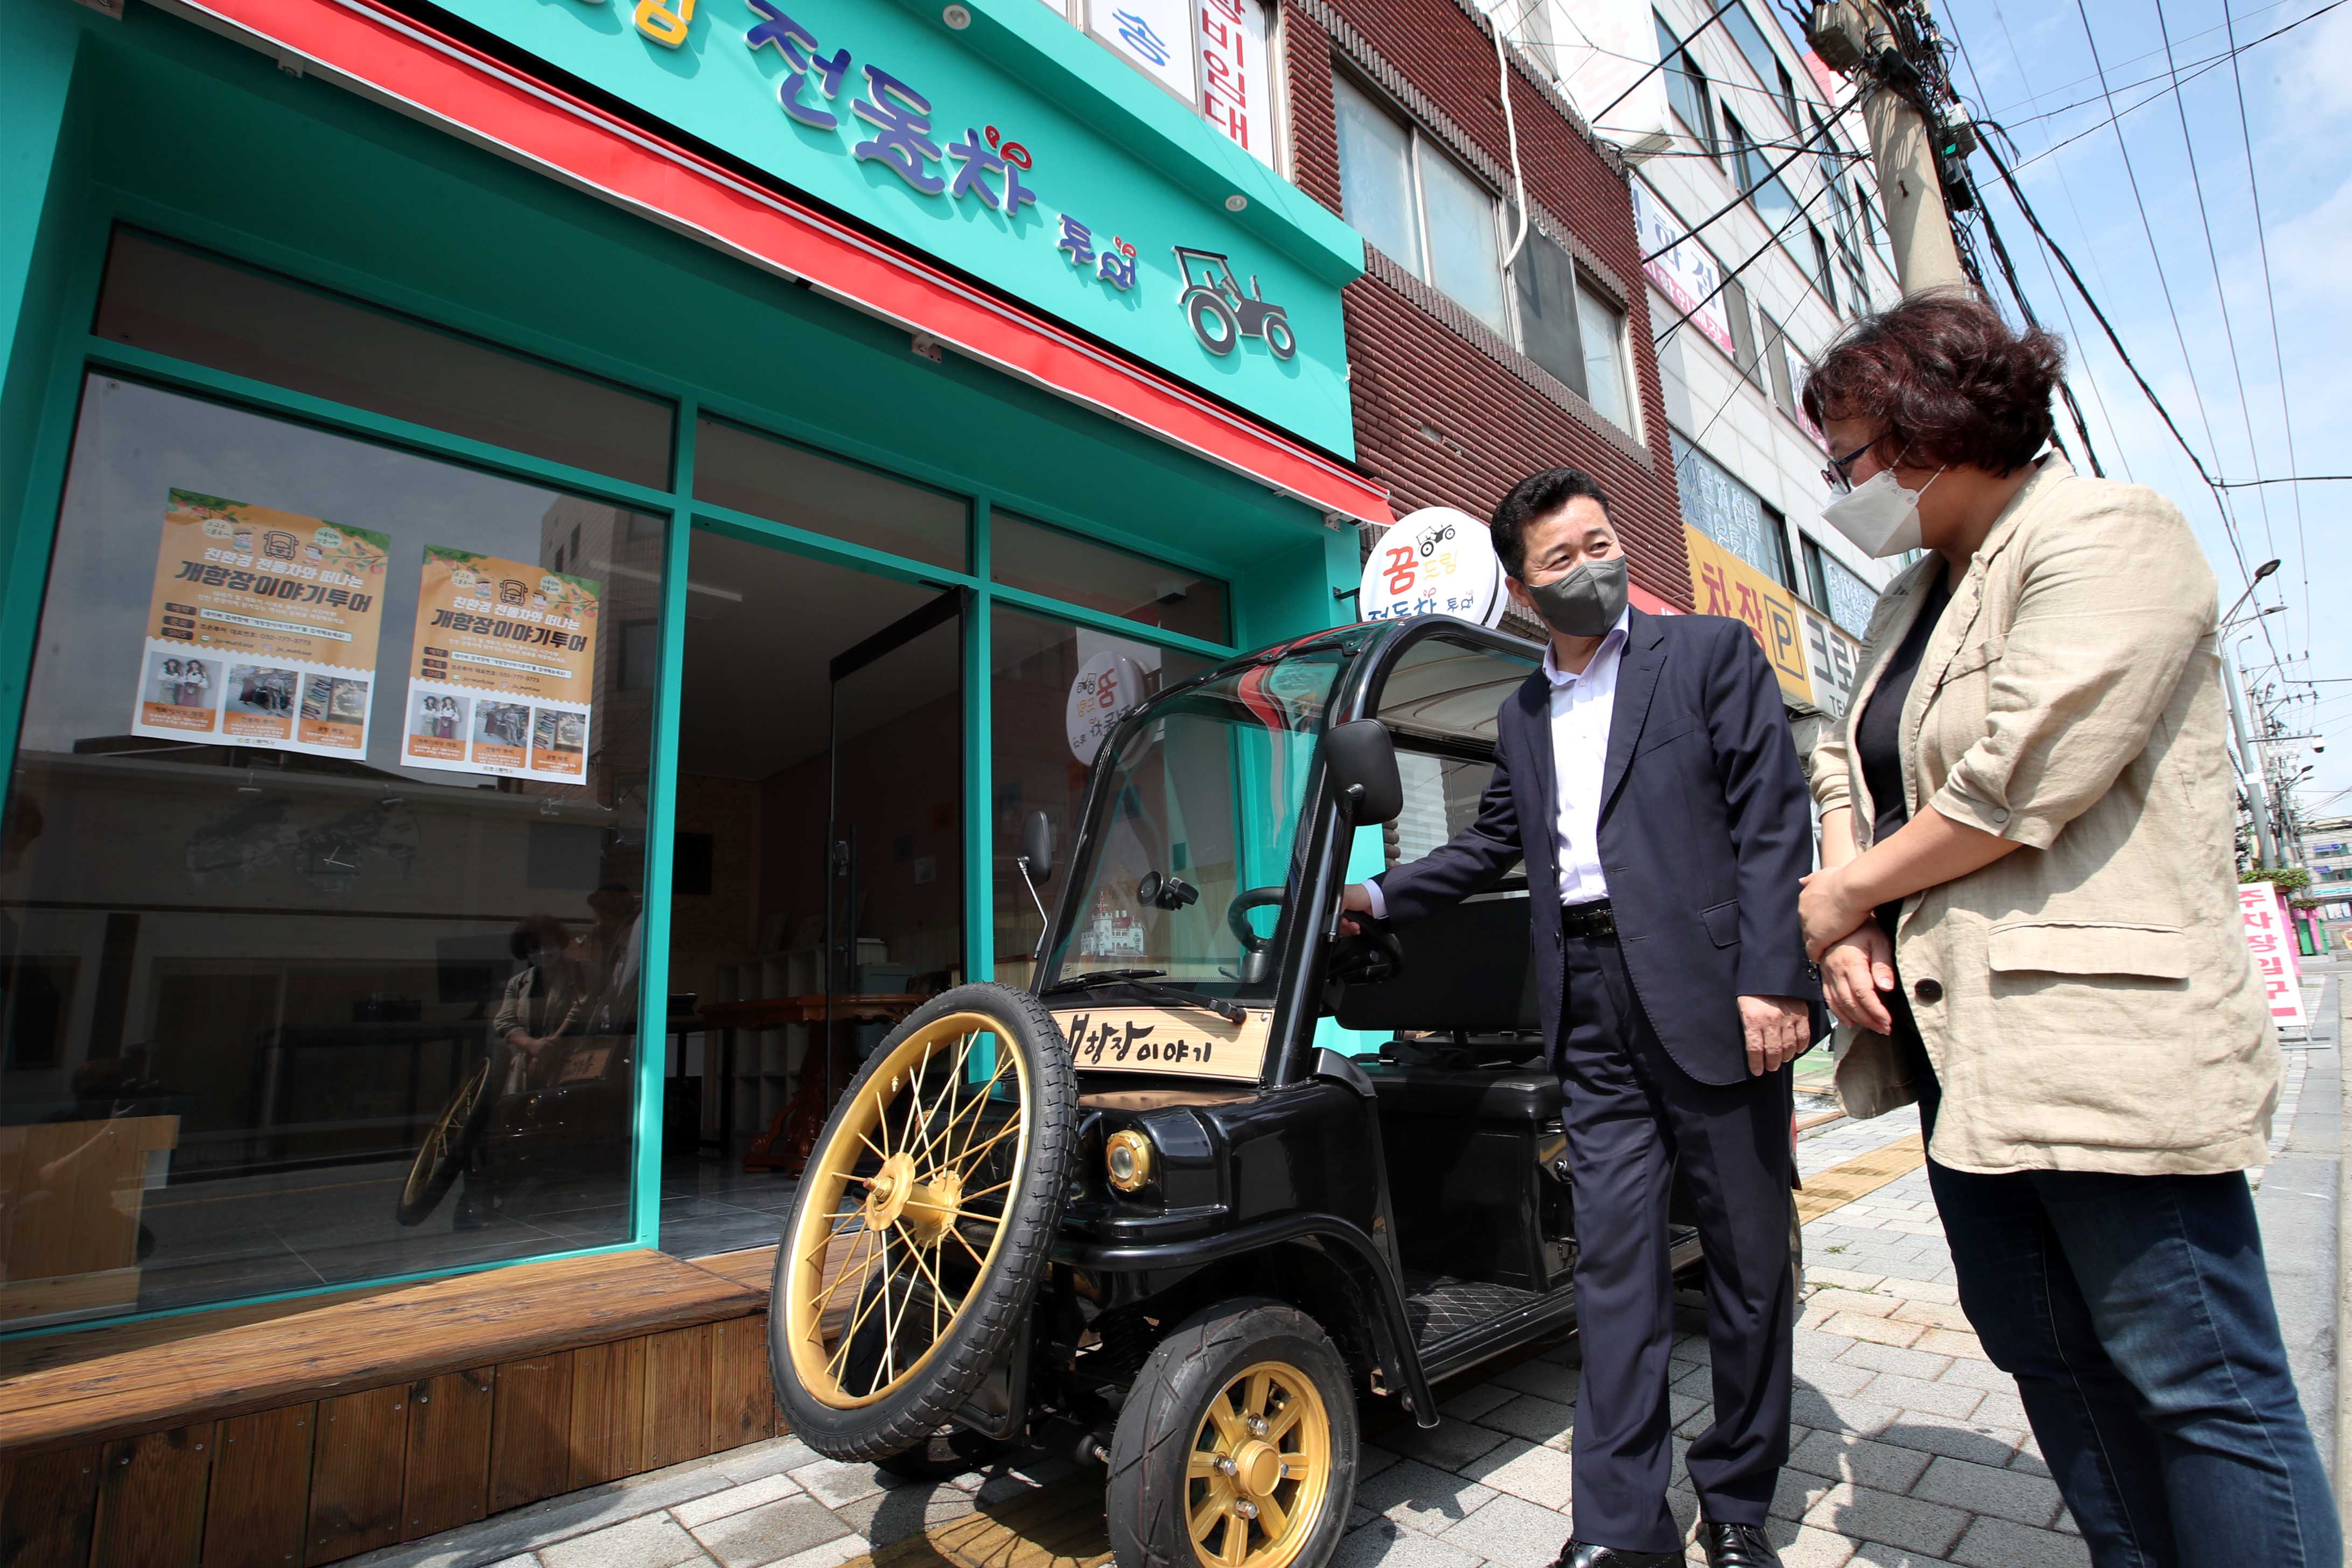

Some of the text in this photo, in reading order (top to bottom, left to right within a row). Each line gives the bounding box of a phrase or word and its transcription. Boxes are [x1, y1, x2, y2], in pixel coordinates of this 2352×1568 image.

[744, 0, 1136, 291] 전동차 투어
[174, 559, 372, 613] 개항장이야기투어
[204, 547, 364, 589] 친환경 전동차와 떠나는
[1383, 545, 1419, 596] 꿈
[452, 595, 580, 631] 친환경 전동차와 떠나는
[1447, 596, 1474, 613] 투어
[431, 607, 587, 653] 개항장이야기투어
[1773, 612, 1792, 661] P
[1137, 1039, 1212, 1063] 이야기
